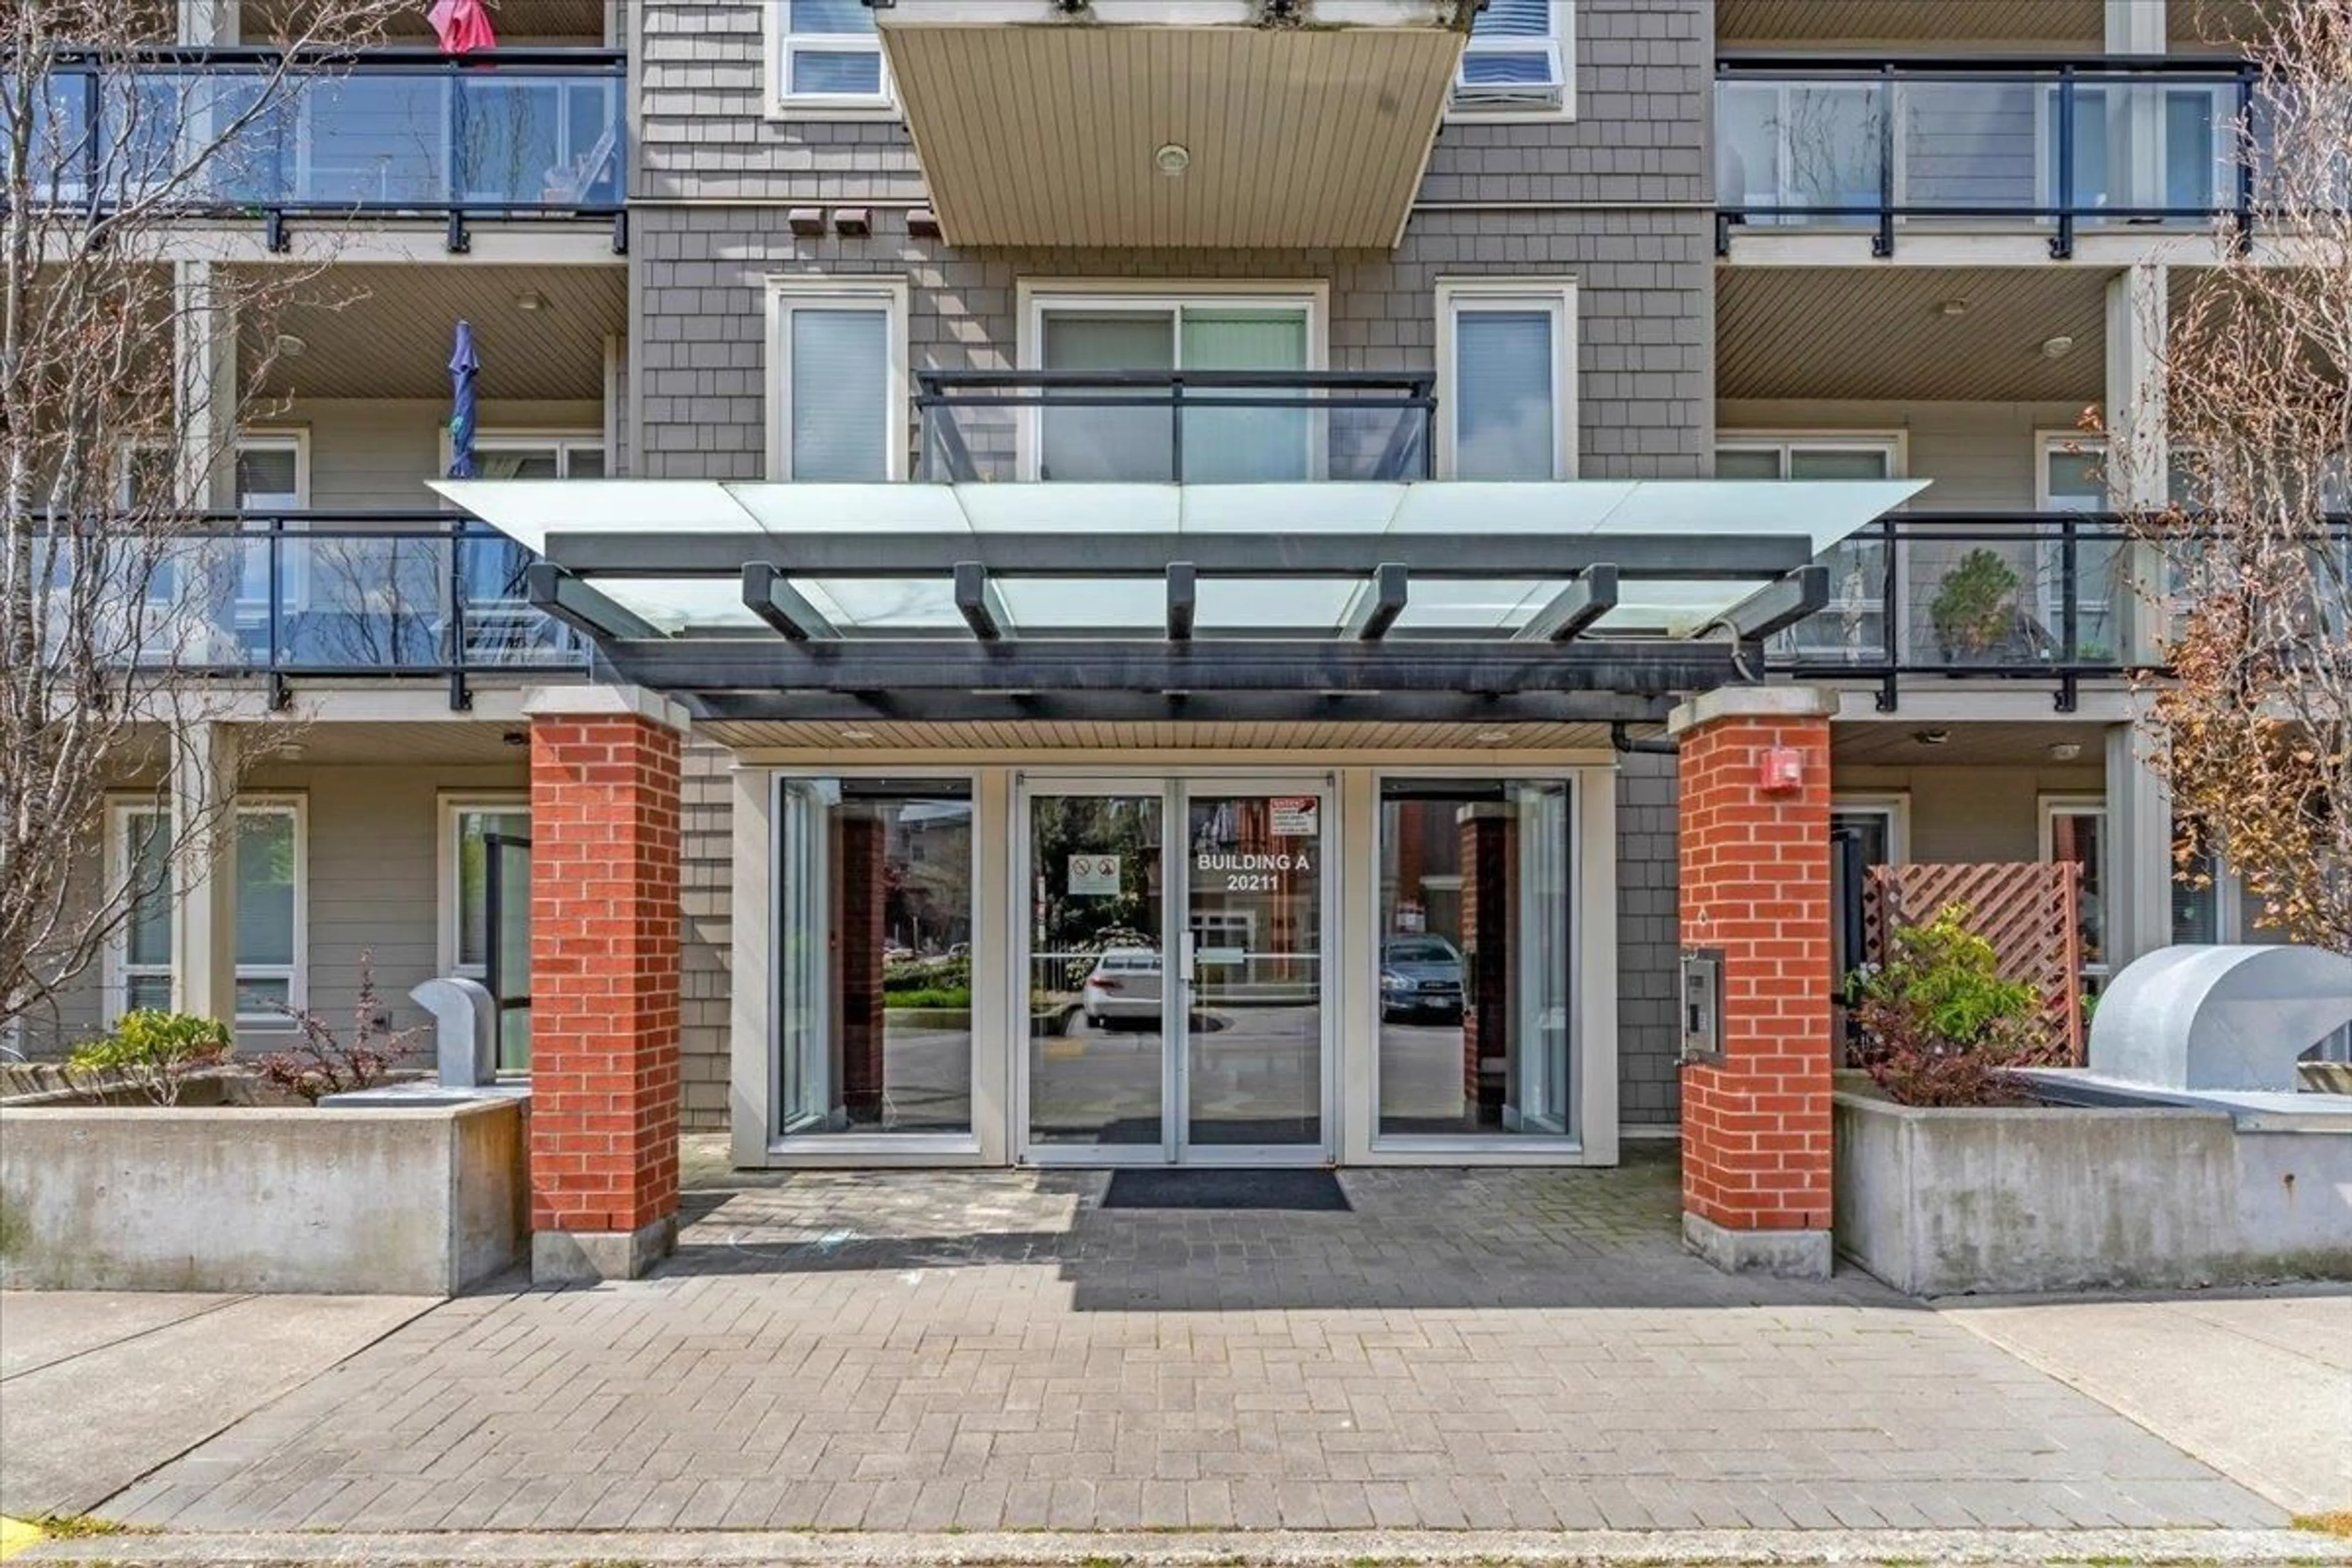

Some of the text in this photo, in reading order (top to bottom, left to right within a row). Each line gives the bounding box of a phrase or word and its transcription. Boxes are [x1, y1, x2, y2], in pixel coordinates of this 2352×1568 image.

[1197, 854, 1310, 870] BUILDING A
[1227, 875, 1278, 891] 20211
